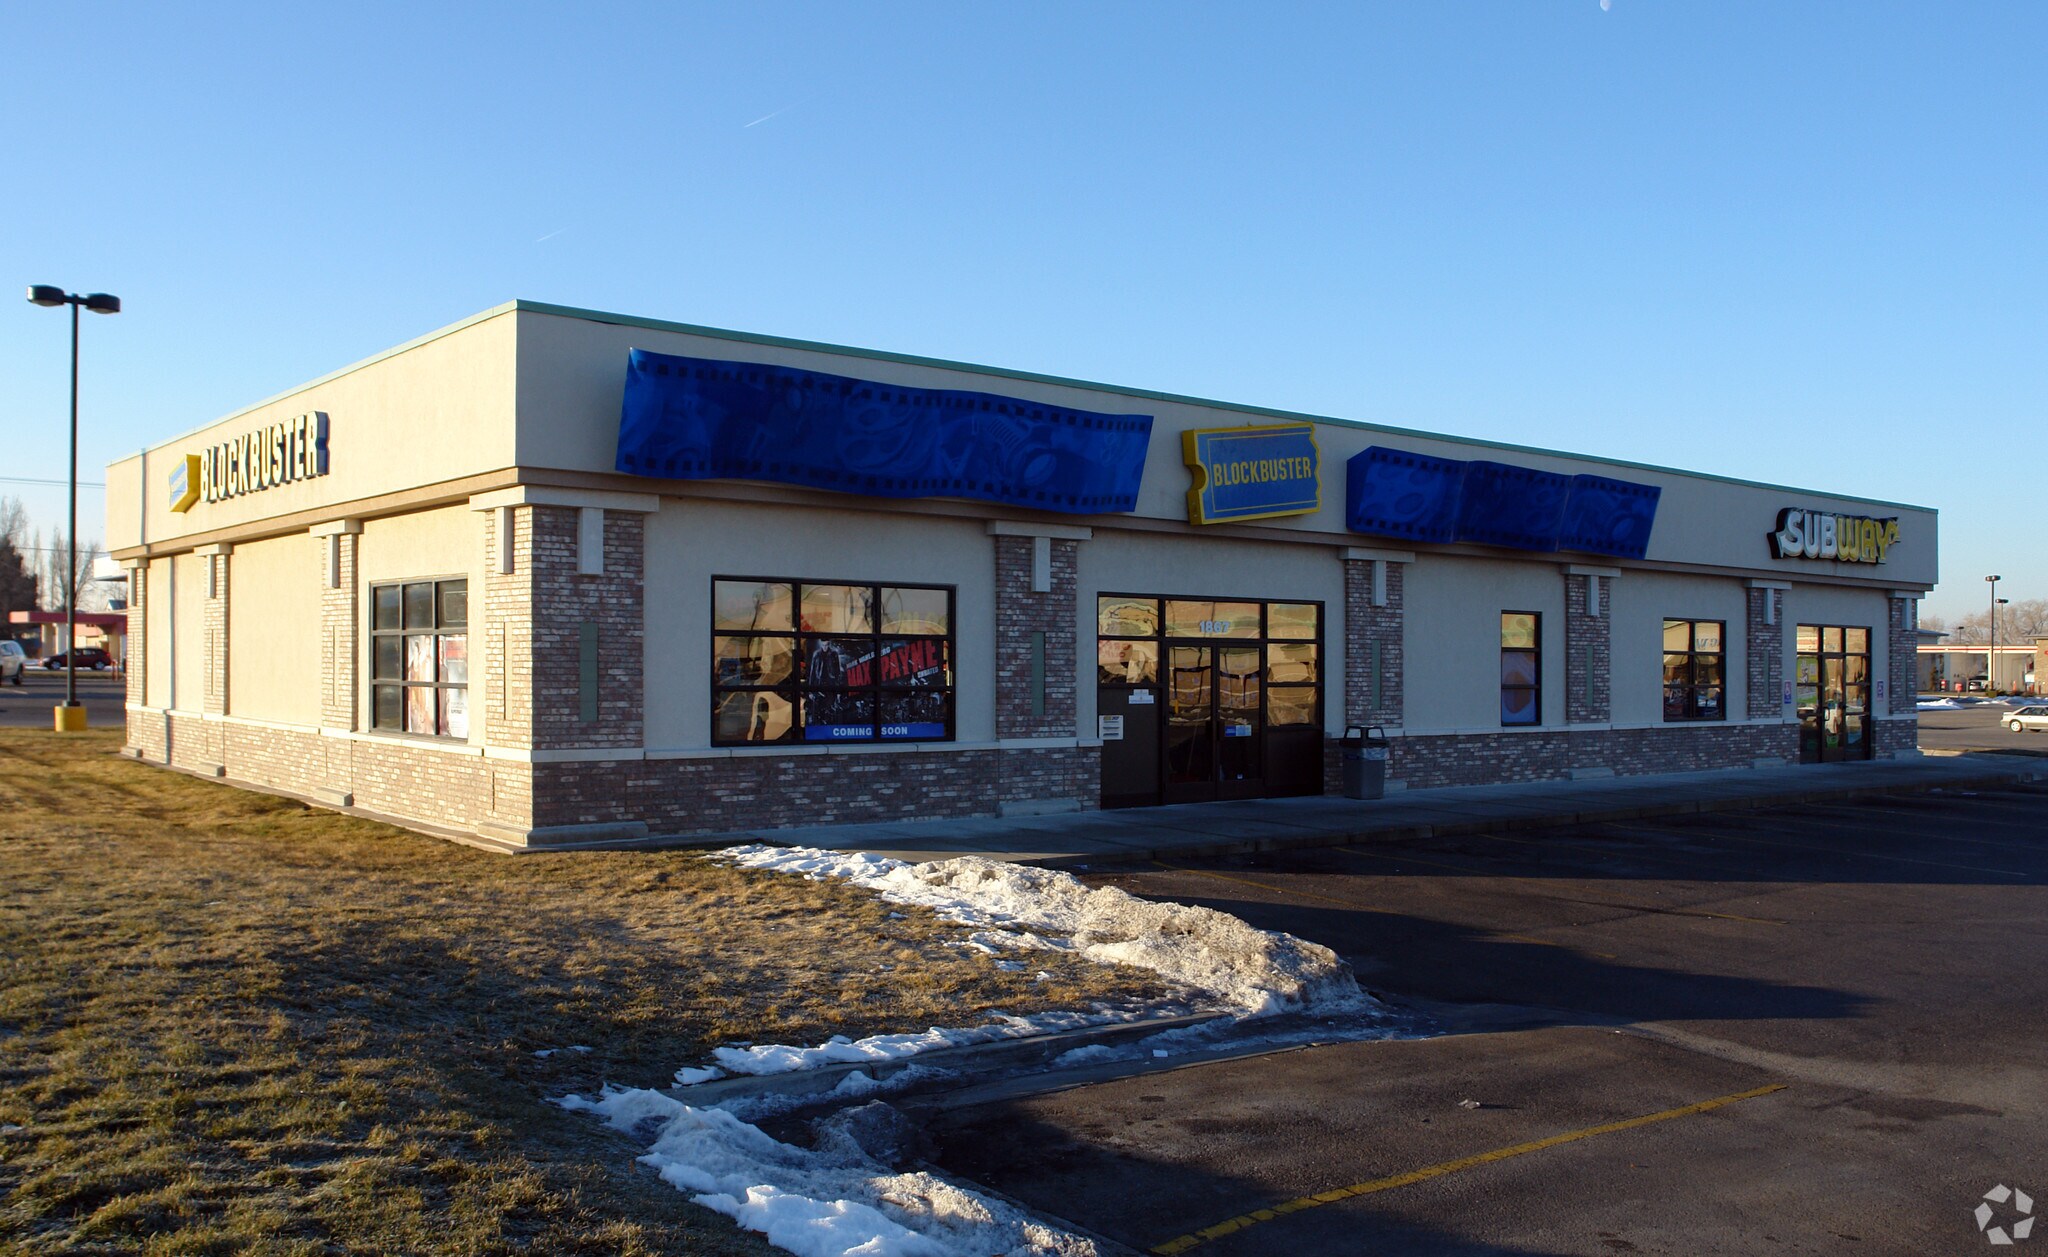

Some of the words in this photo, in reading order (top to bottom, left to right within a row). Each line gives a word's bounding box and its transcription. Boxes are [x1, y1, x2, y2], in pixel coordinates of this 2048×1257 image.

[200, 411, 325, 503] BLOCKBUSTER
[1213, 457, 1311, 487] BLOCKBUSTER
[1769, 508, 1900, 563] SUBWAY
[1199, 620, 1230, 633] 1867
[847, 661, 872, 692] MAX
[880, 640, 938, 682] PAYNE
[833, 727, 872, 737] COMING
[881, 726, 908, 735] SOON
